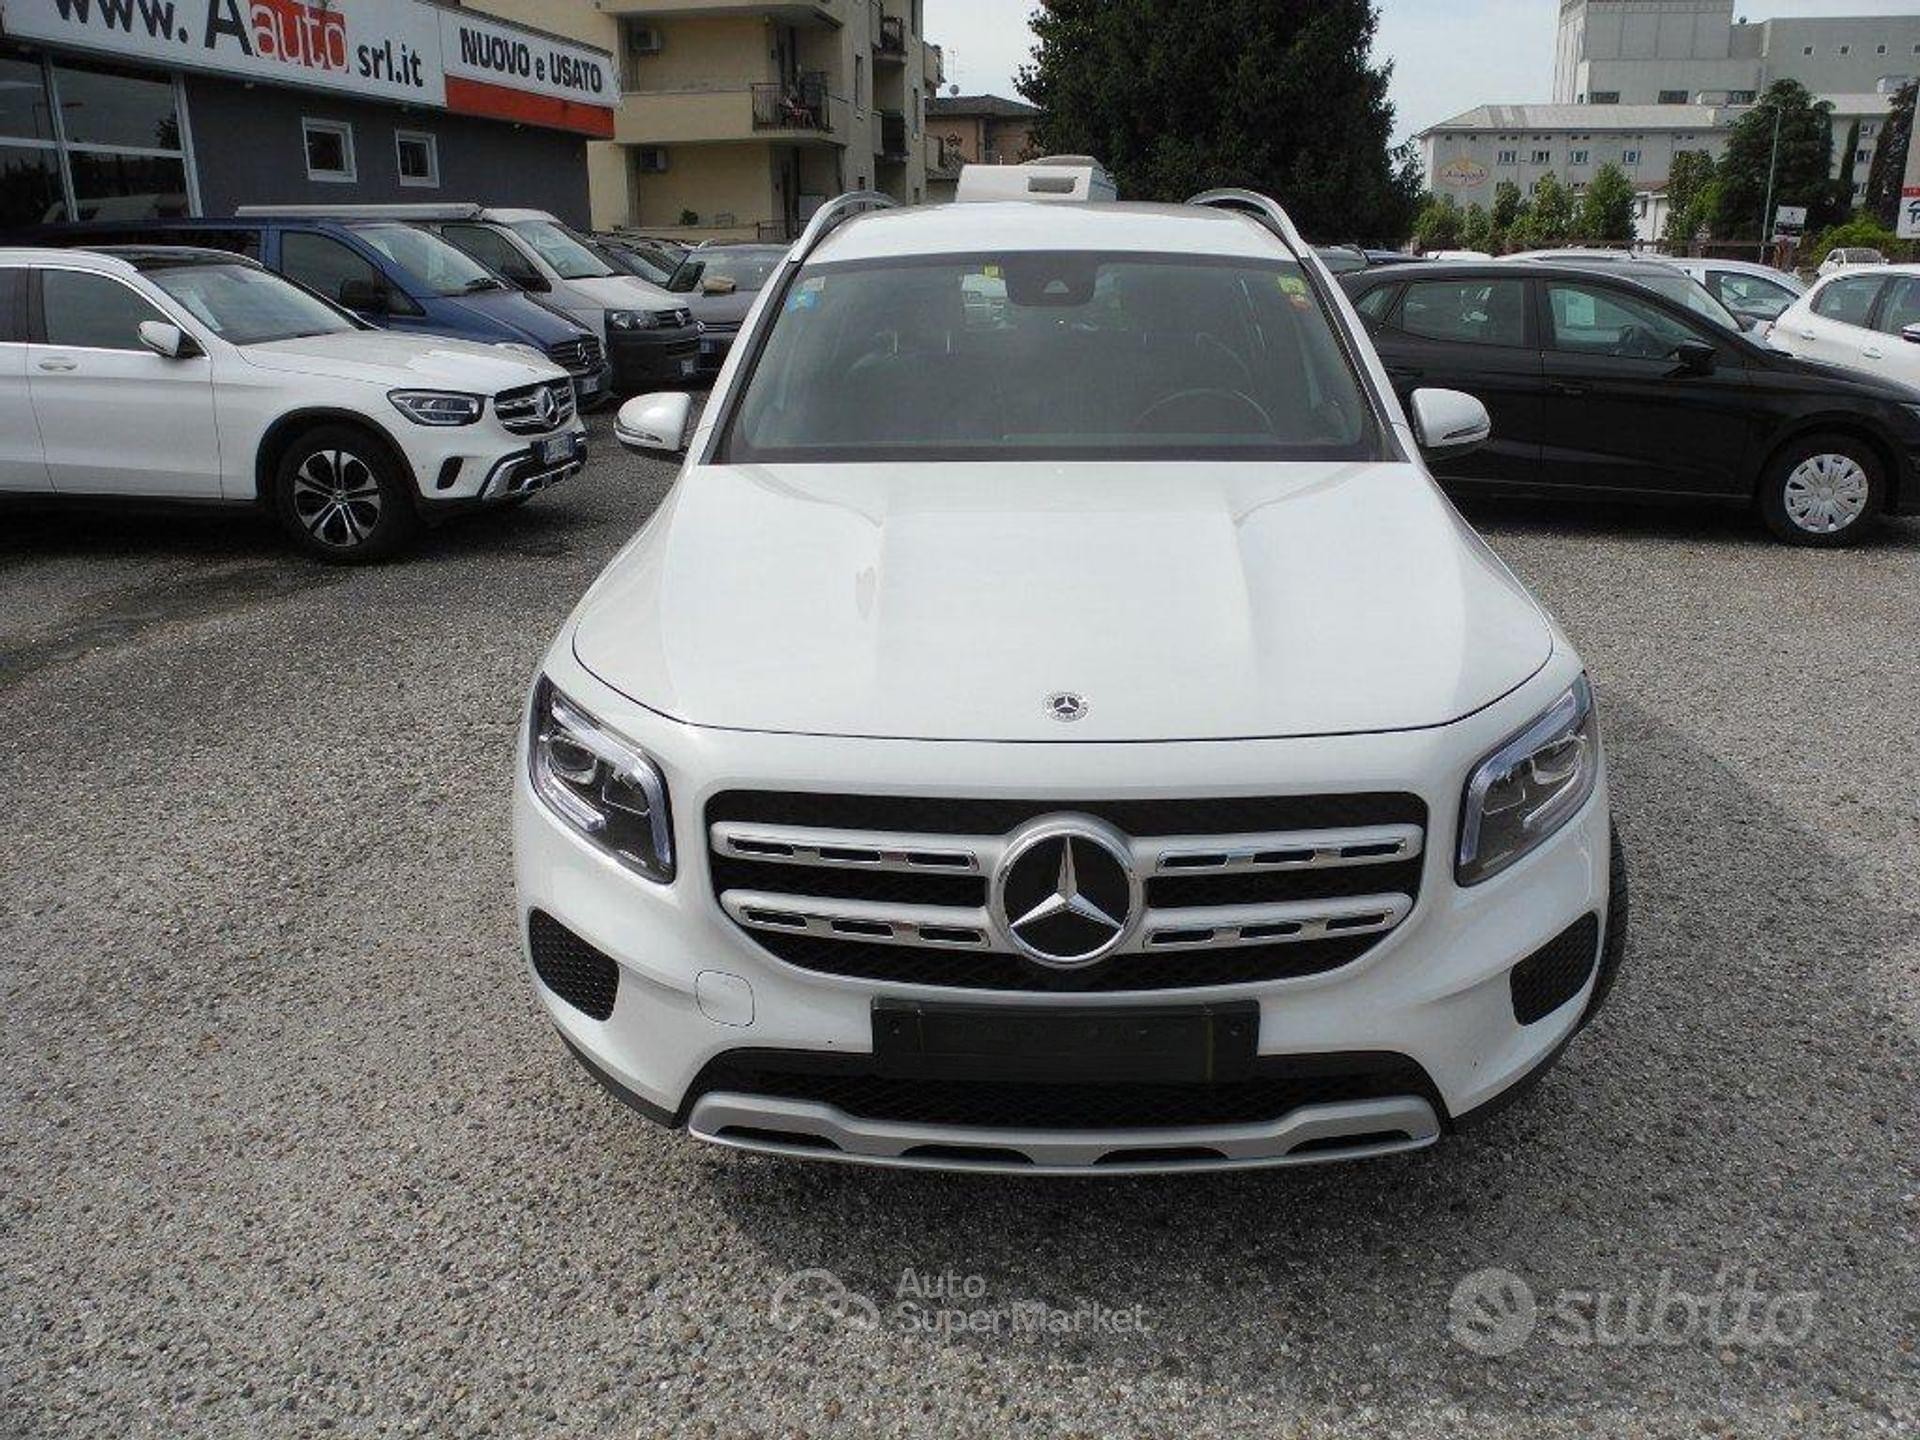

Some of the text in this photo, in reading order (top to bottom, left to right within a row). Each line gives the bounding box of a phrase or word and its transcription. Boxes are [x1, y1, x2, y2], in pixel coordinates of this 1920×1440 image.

[459, 27, 603, 93] NUOVO e USATO
